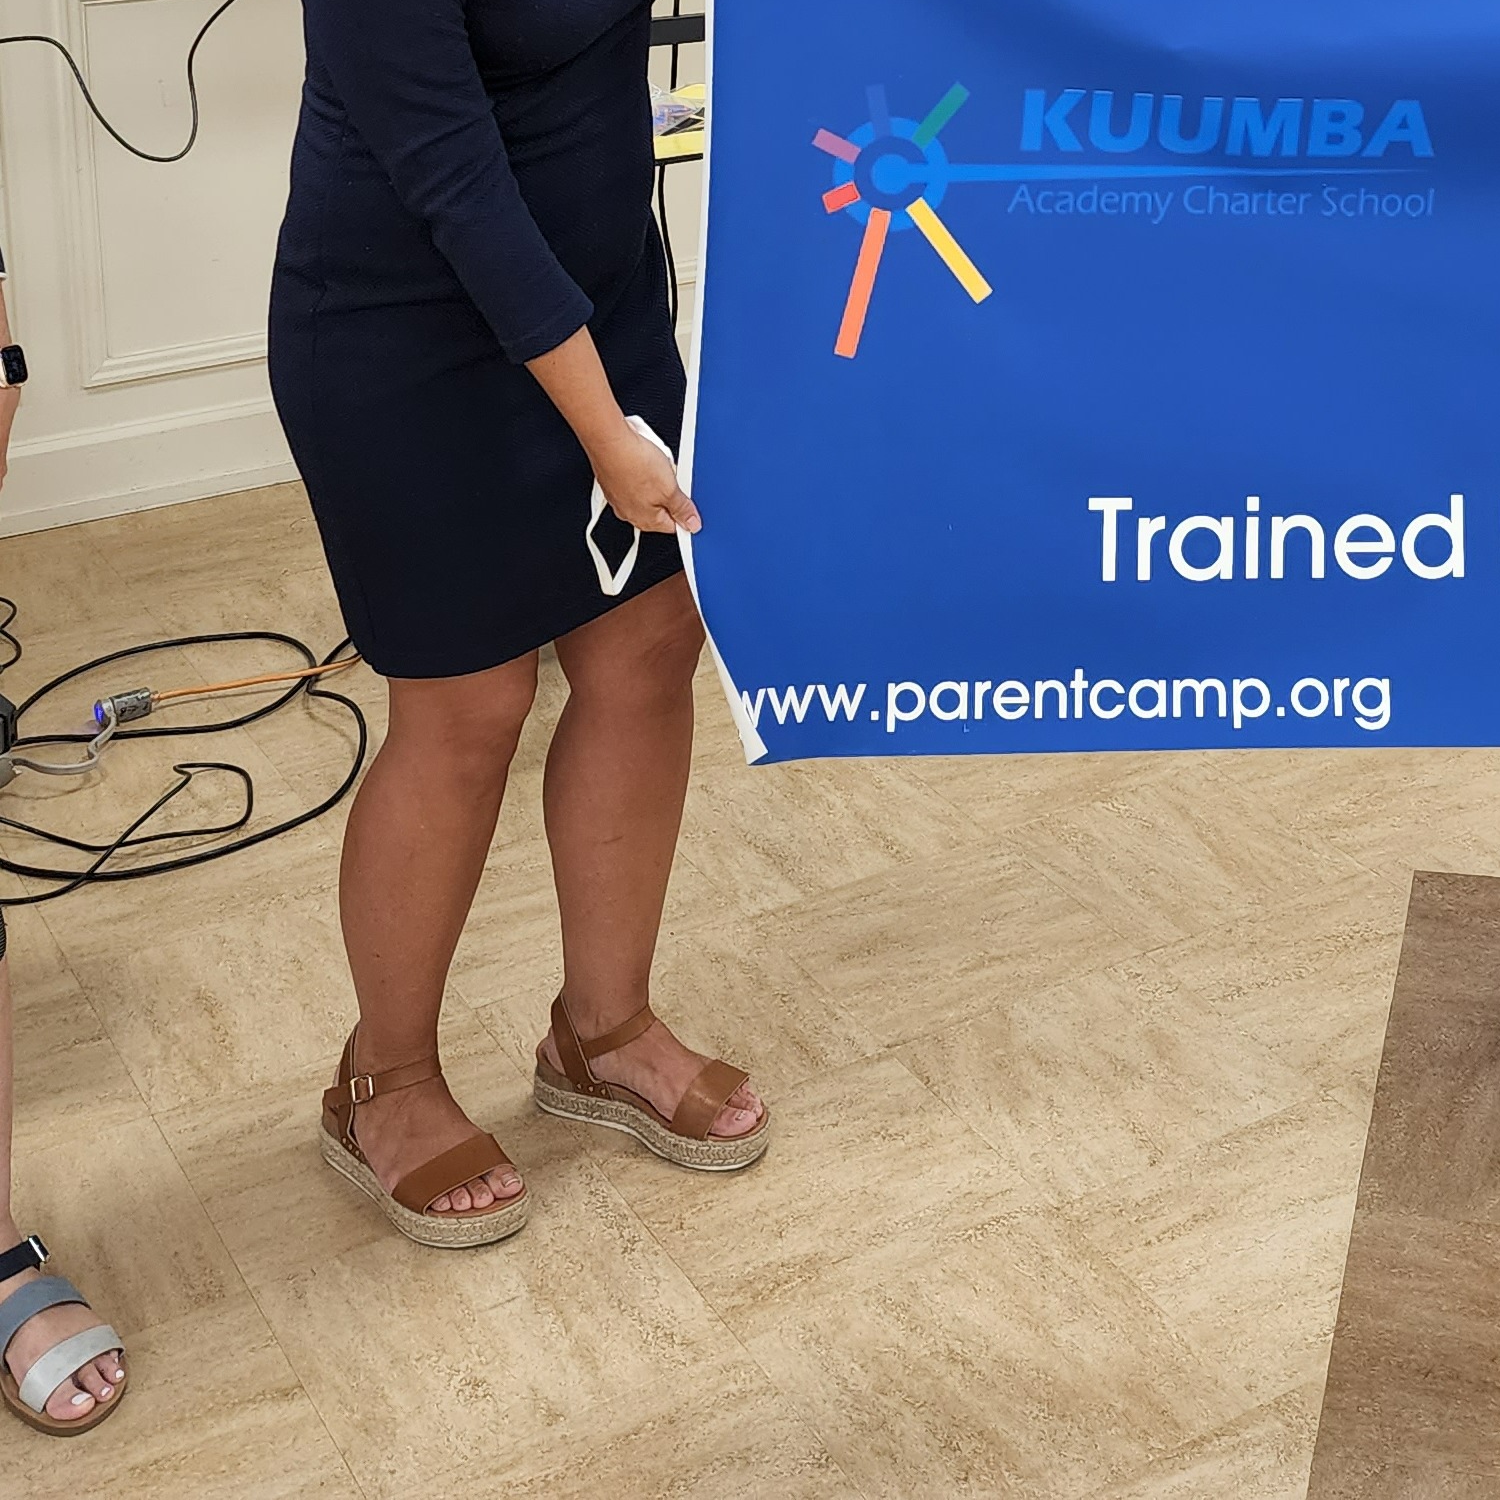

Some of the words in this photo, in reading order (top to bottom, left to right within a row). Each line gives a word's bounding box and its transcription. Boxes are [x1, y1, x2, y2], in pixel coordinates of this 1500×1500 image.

[1019, 88, 1435, 158] KUUMBA
[1007, 184, 1172, 225] Academy
[1183, 184, 1311, 218] Charter
[1321, 186, 1435, 218] School
[1088, 495, 1464, 581] Trained
